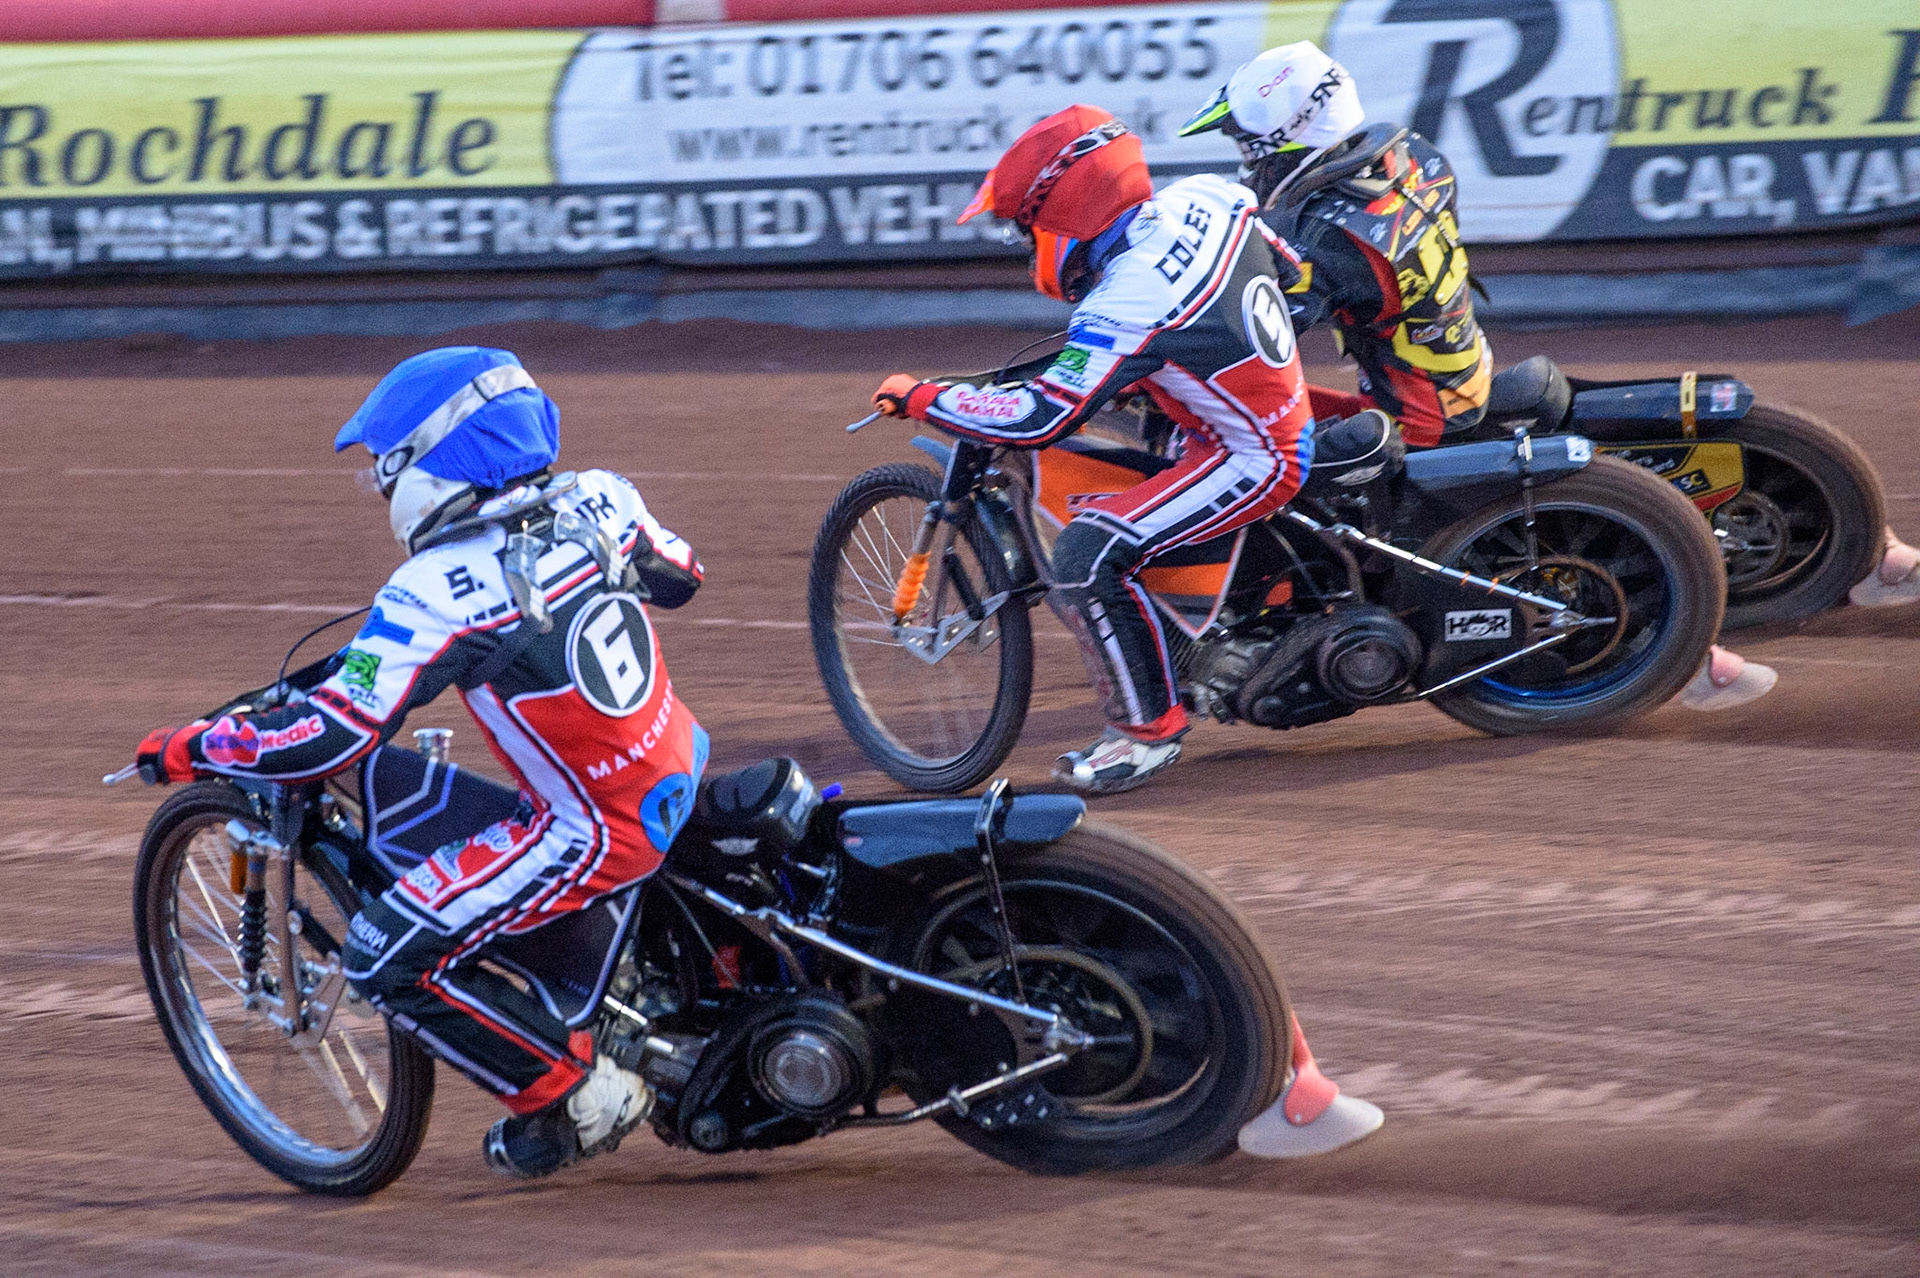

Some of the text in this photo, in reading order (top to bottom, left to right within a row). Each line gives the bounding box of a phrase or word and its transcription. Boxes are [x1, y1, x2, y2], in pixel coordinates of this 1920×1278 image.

[748, 30, 952, 97] 01706
[971, 18, 1219, 90] 640055
[0, 91, 497, 188] Rochdale
[334, 198, 382, 260] &
[388, 189, 827, 256] REFRIGERATED
[1631, 156, 1794, 226] CAR,
[582, 599, 645, 710] 6
